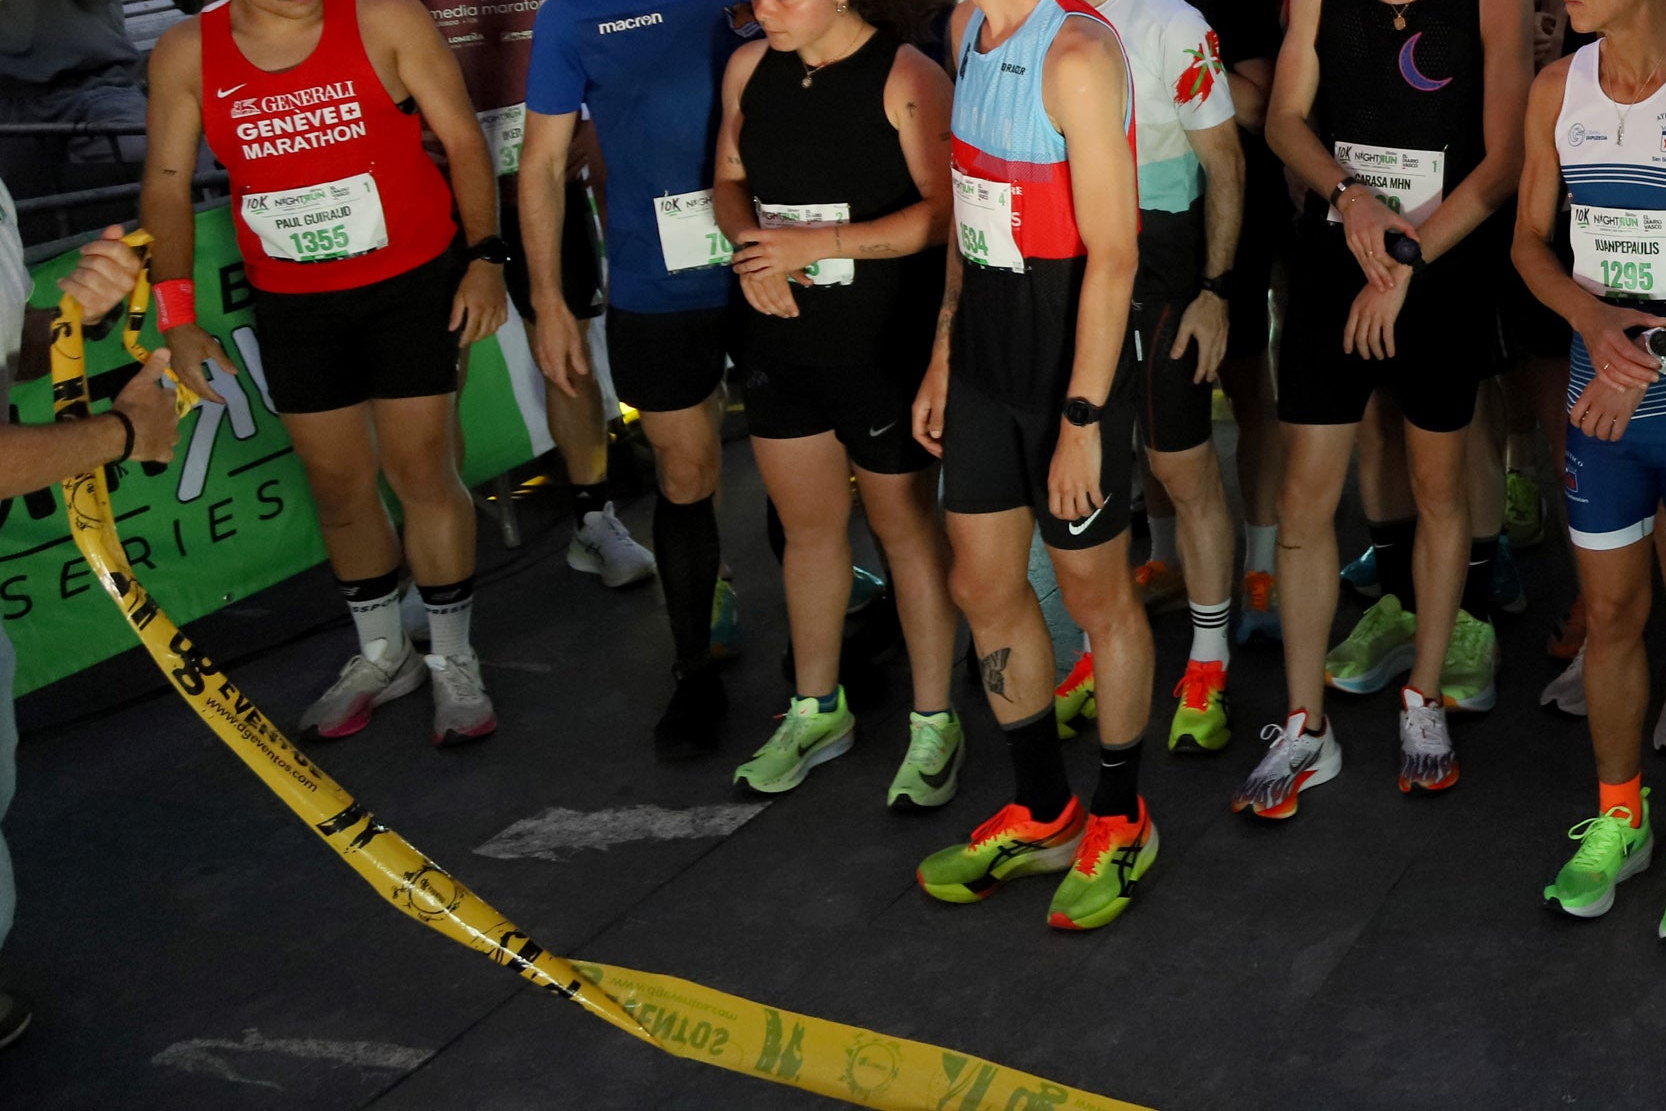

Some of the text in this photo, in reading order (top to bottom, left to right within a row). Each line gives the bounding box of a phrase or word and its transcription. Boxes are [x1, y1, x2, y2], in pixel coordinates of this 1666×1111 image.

[430, 5, 479, 19] media
[599, 12, 664, 35] macron
[261, 80, 357, 113] GENERALI
[236, 106, 339, 141] GENÈVE
[242, 121, 367, 160] MARATHON
[1432, 160, 1438, 173] 1
[1389, 177, 1411, 190] MHN
[660, 197, 680, 212] 10K
[998, 192, 1006, 207] 4
[275, 206, 352, 229] PAUL GUIRAUD
[835, 212, 843, 224] 2
[1574, 208, 1590, 226] 10K
[289, 224, 350, 255] 1355
[1595, 239, 1660, 255] JUANPEPAULIS
[1600, 260, 1654, 291] 1295
[1, 479, 284, 620] SERIES
